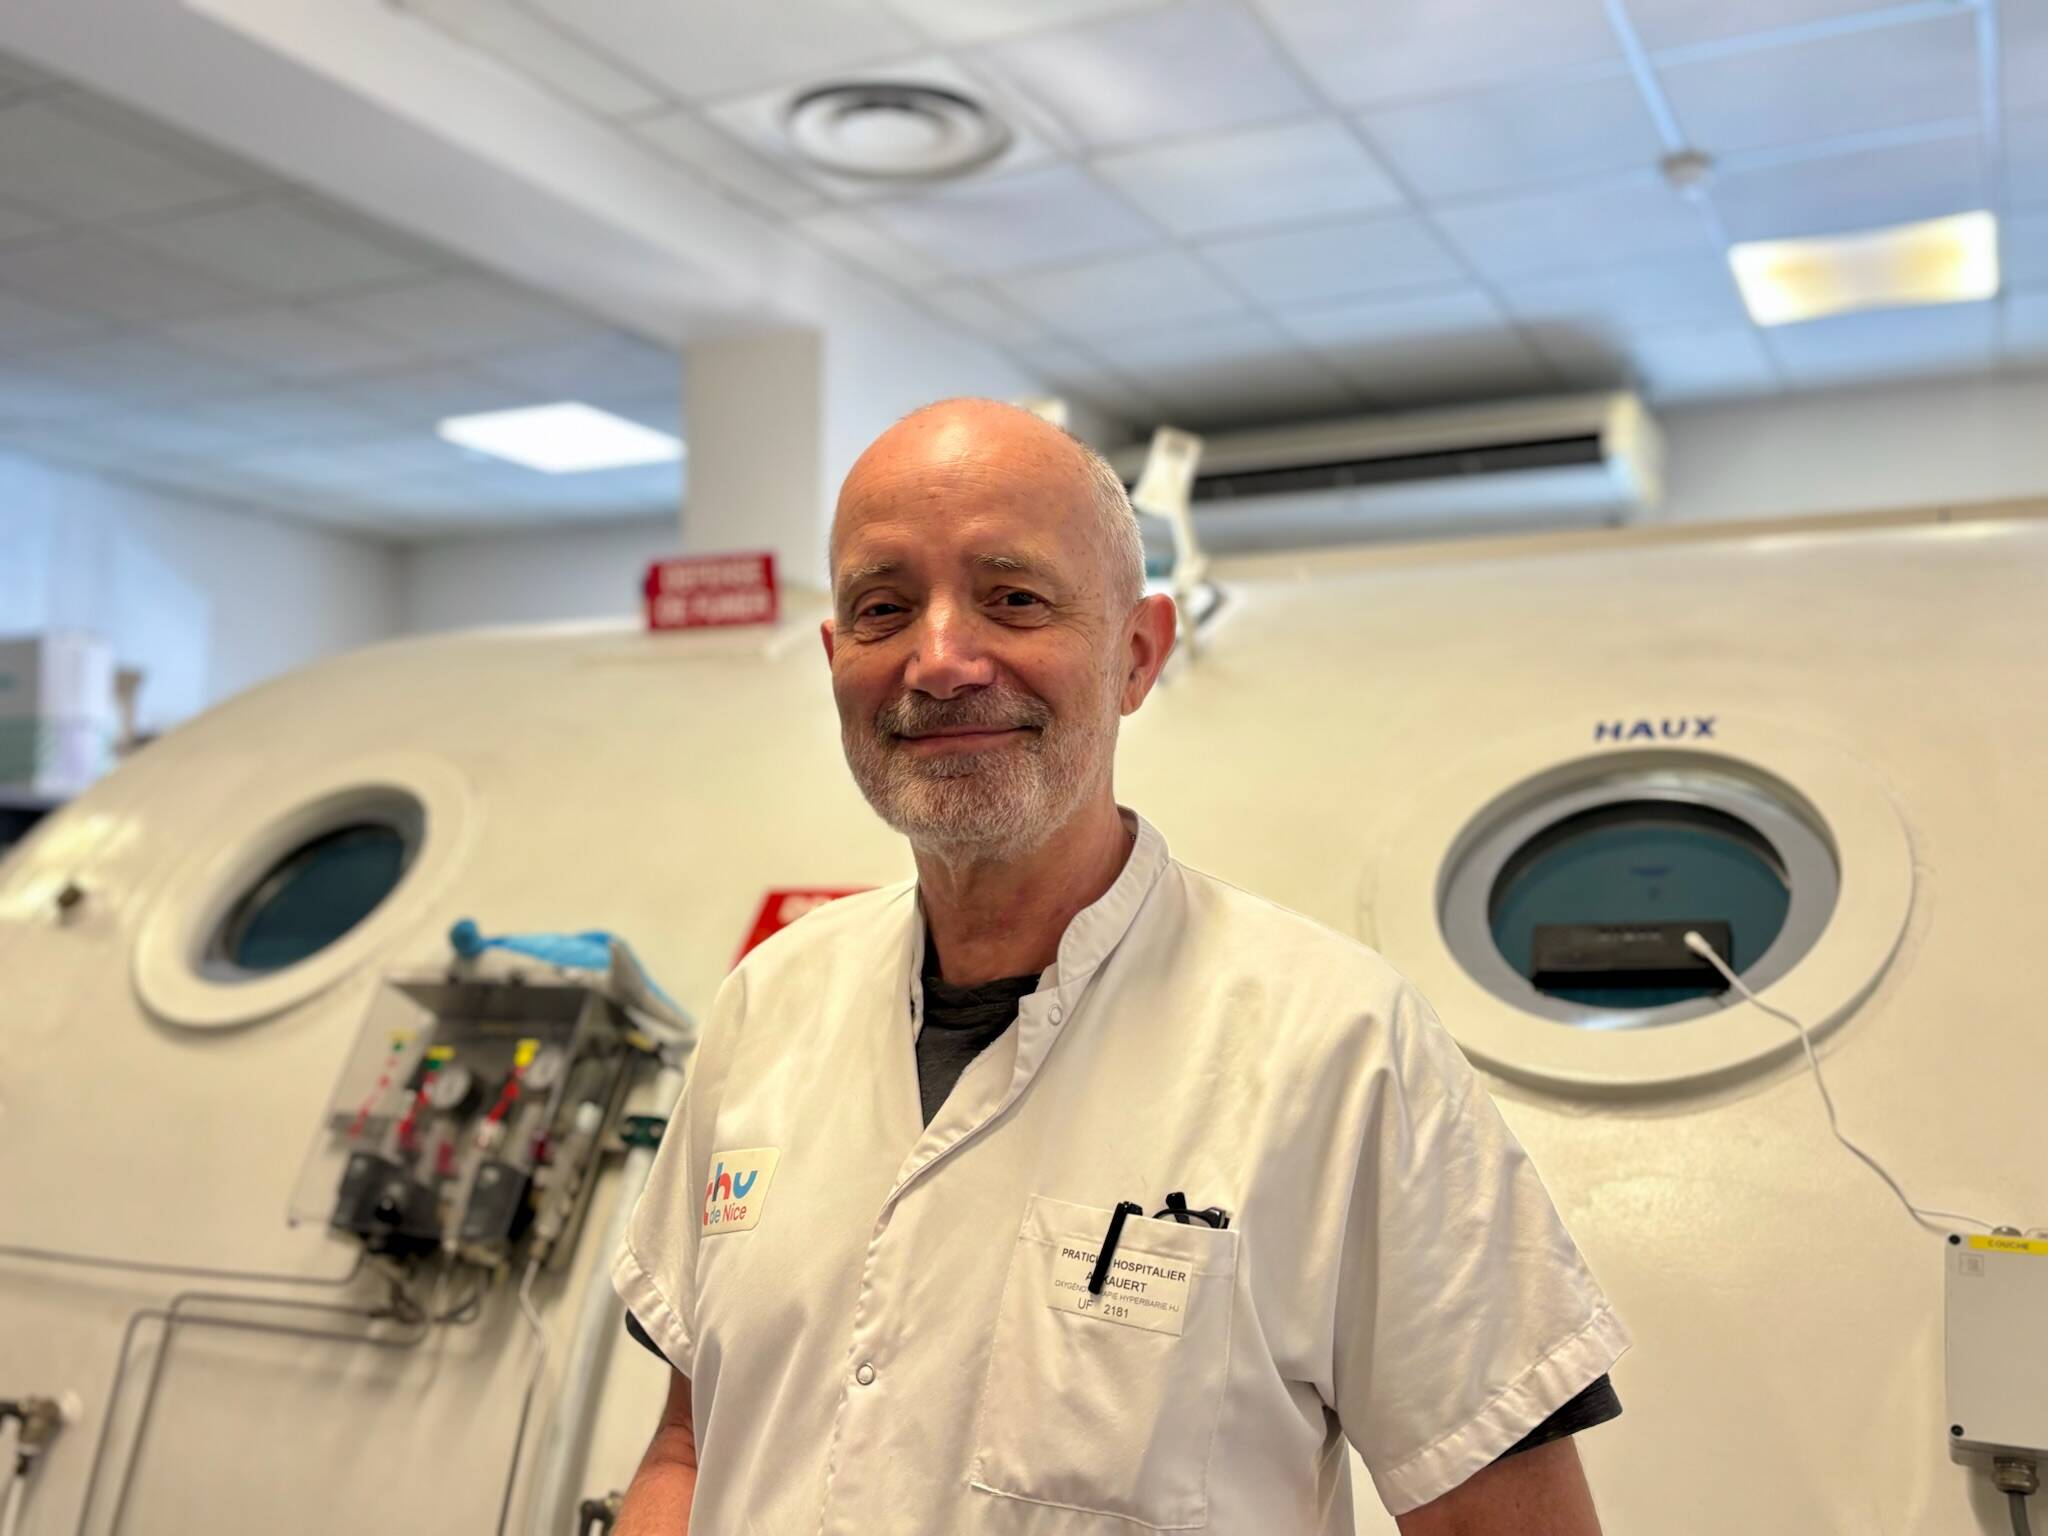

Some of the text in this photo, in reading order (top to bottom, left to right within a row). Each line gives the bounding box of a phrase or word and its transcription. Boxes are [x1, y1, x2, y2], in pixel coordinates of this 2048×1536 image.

[1594, 717, 1715, 741] HAUX
[722, 1202, 748, 1223] Nice
[1113, 1259, 1187, 1282] HOSPITALIER
[1078, 1297, 1129, 1319] UF 2181
